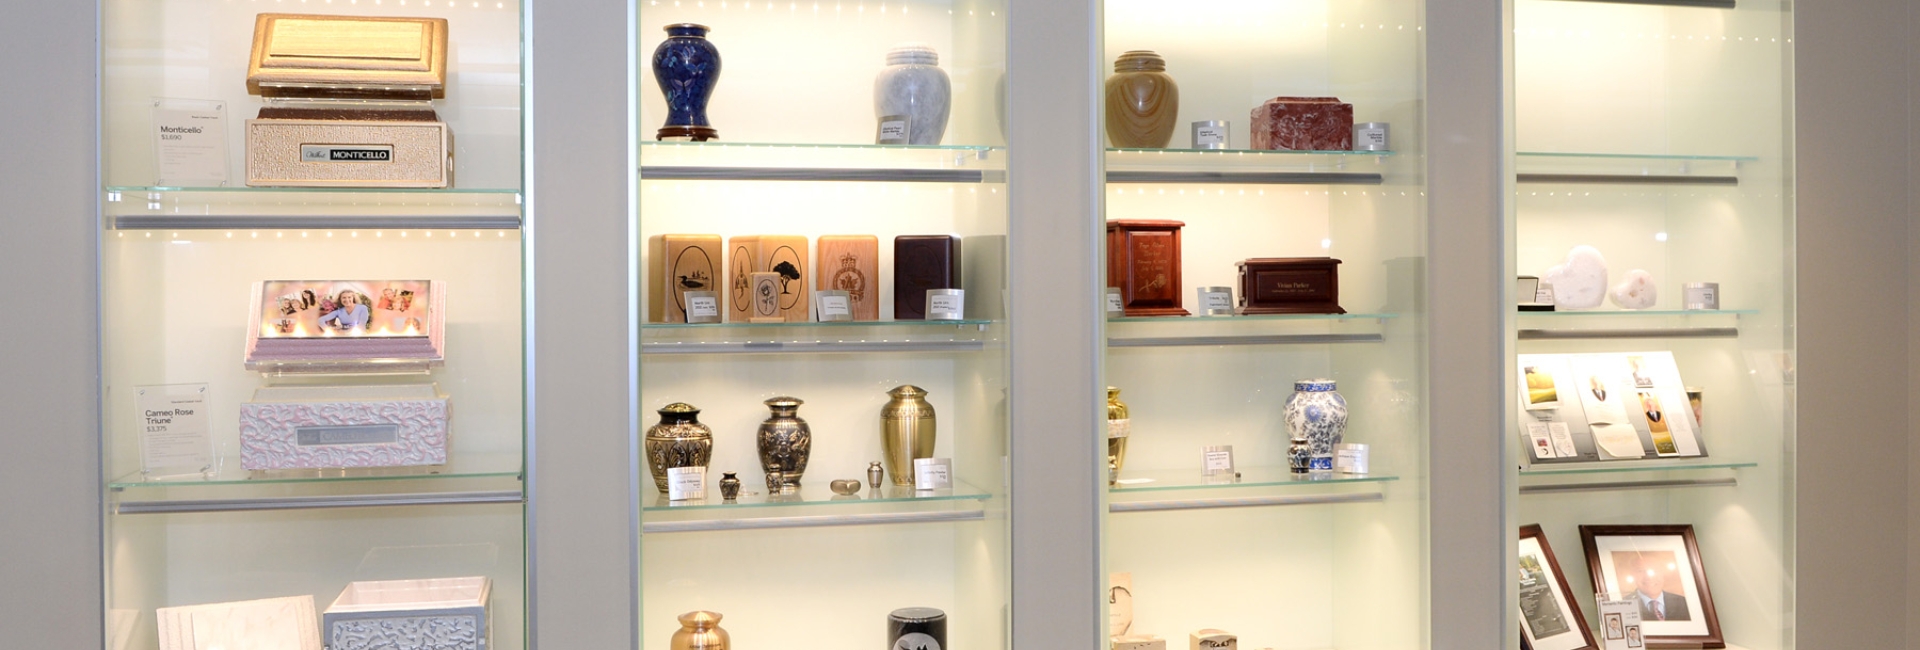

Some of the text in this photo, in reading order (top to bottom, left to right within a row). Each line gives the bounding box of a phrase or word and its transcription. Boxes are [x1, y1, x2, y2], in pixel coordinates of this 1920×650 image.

[332, 150, 387, 160] MONTICELLO
[145, 408, 194, 417] Cameo Rose
